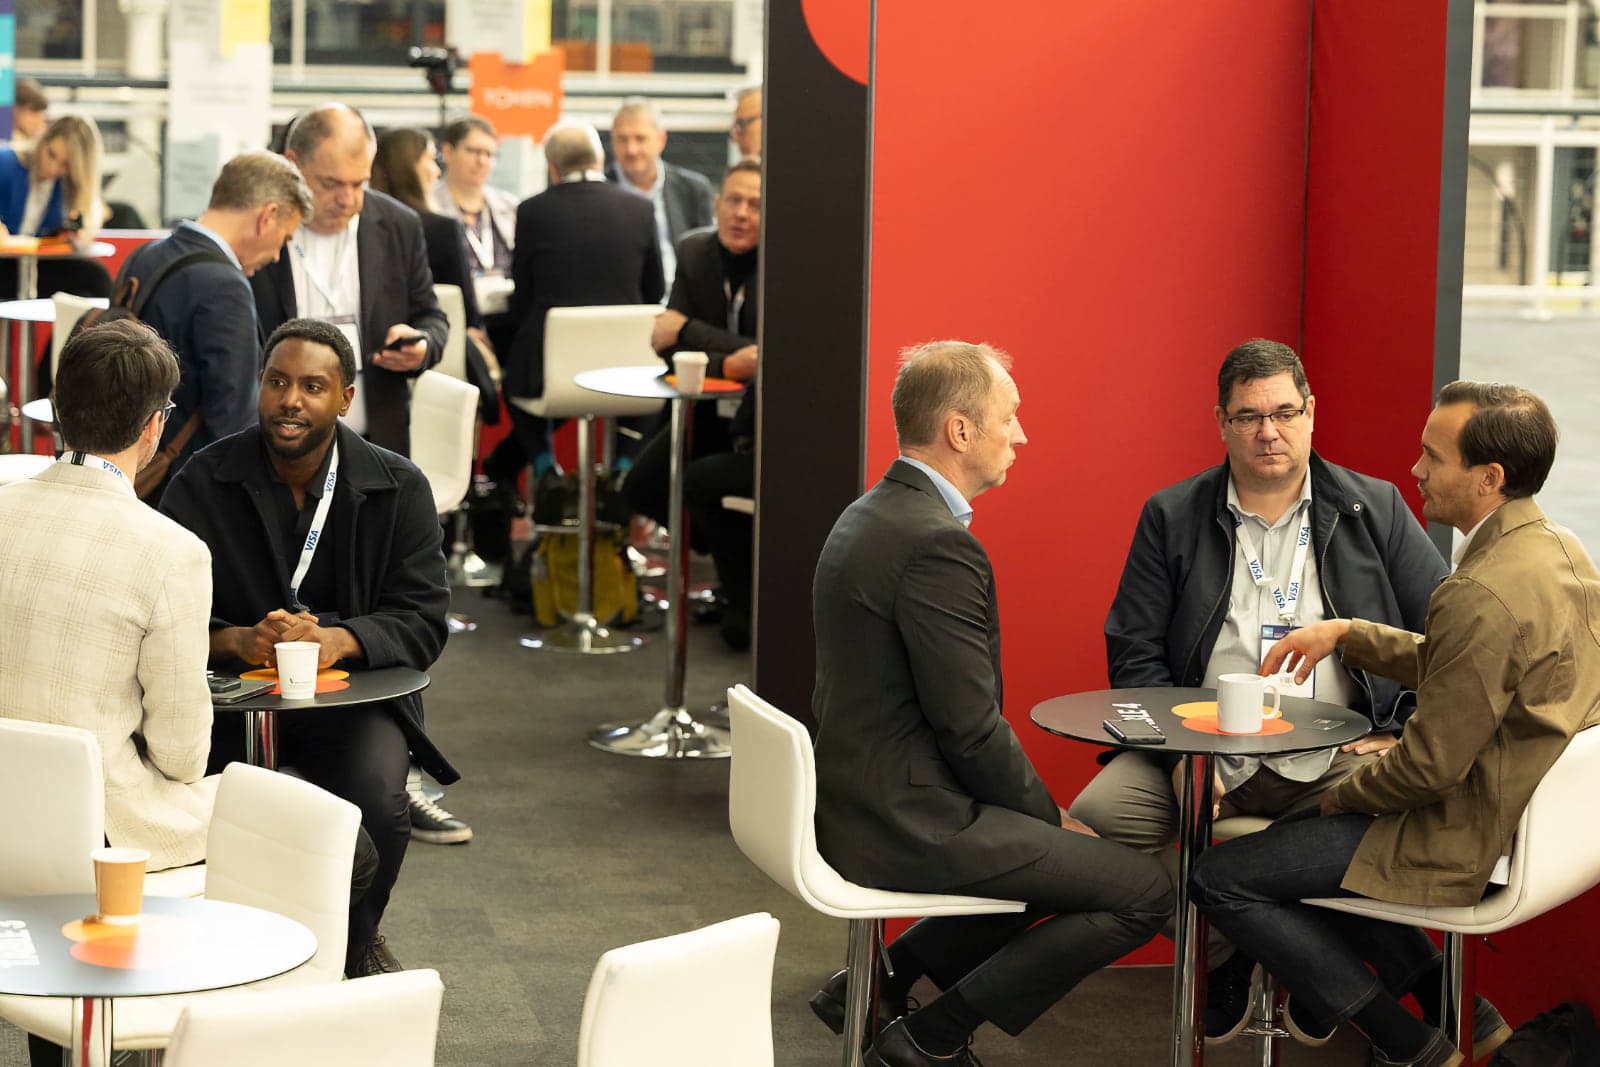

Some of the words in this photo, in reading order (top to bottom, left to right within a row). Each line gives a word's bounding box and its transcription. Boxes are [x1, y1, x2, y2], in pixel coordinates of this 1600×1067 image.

[103, 460, 123, 480] VISA
[325, 471, 336, 492] VISA
[304, 530, 319, 551] VISA
[1299, 526, 1310, 547] VISA
[1250, 559, 1263, 580] VISA
[1273, 587, 1286, 609] VISA
[1288, 582, 1300, 601] VISA
